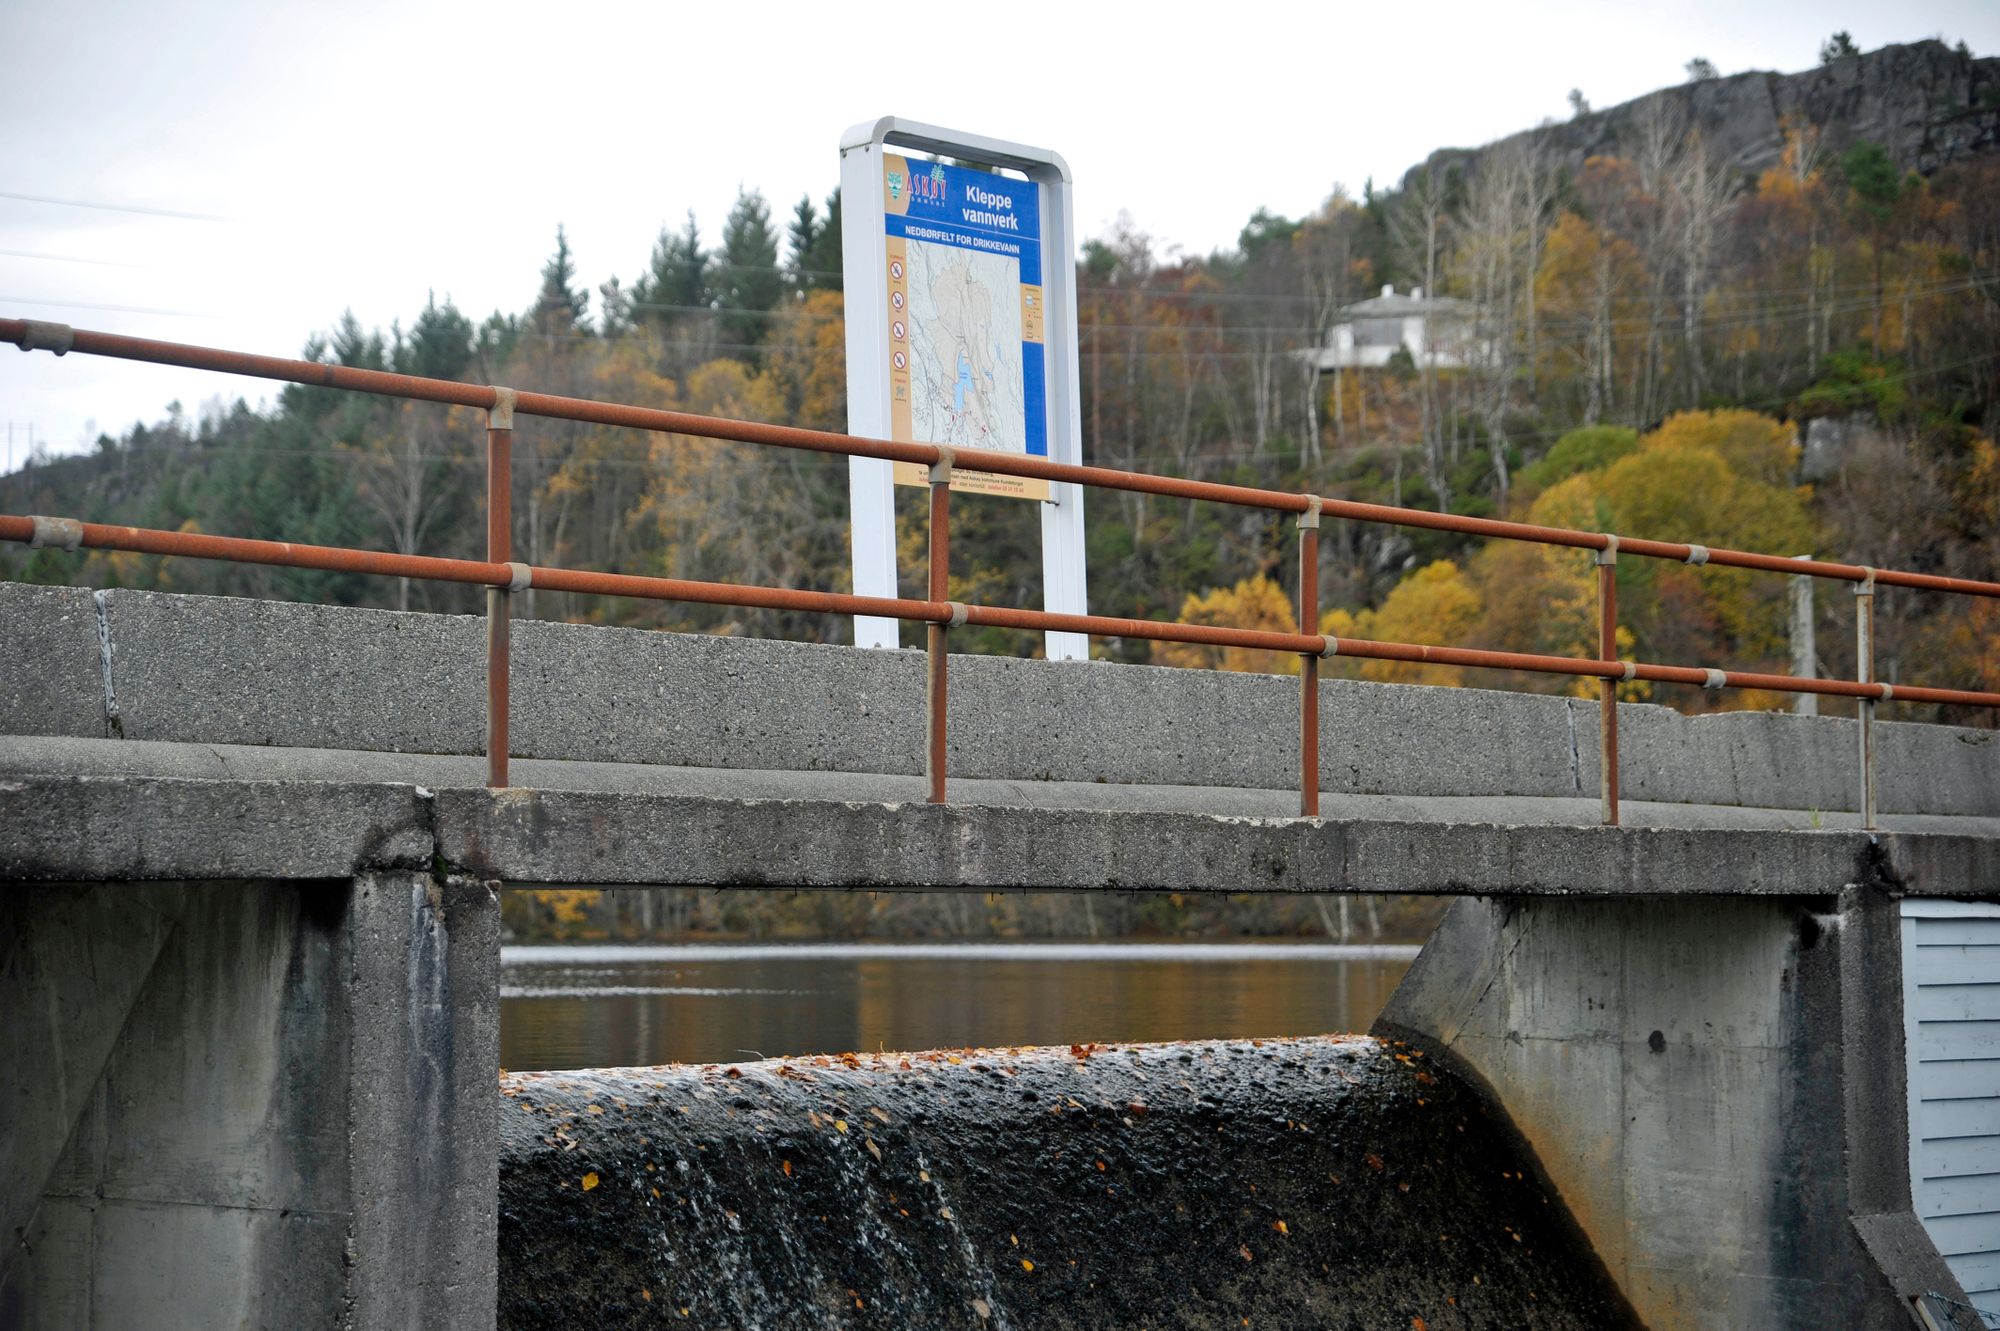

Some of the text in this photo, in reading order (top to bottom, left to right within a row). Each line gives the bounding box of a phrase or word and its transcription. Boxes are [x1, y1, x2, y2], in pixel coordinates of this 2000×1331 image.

[906, 174, 946, 200] ASKØY
[966, 185, 1012, 209] Kleppe
[962, 208, 1018, 230] vannverk
[905, 225, 1020, 254] NEDBØRFELT FOR DRIKKEVANN
